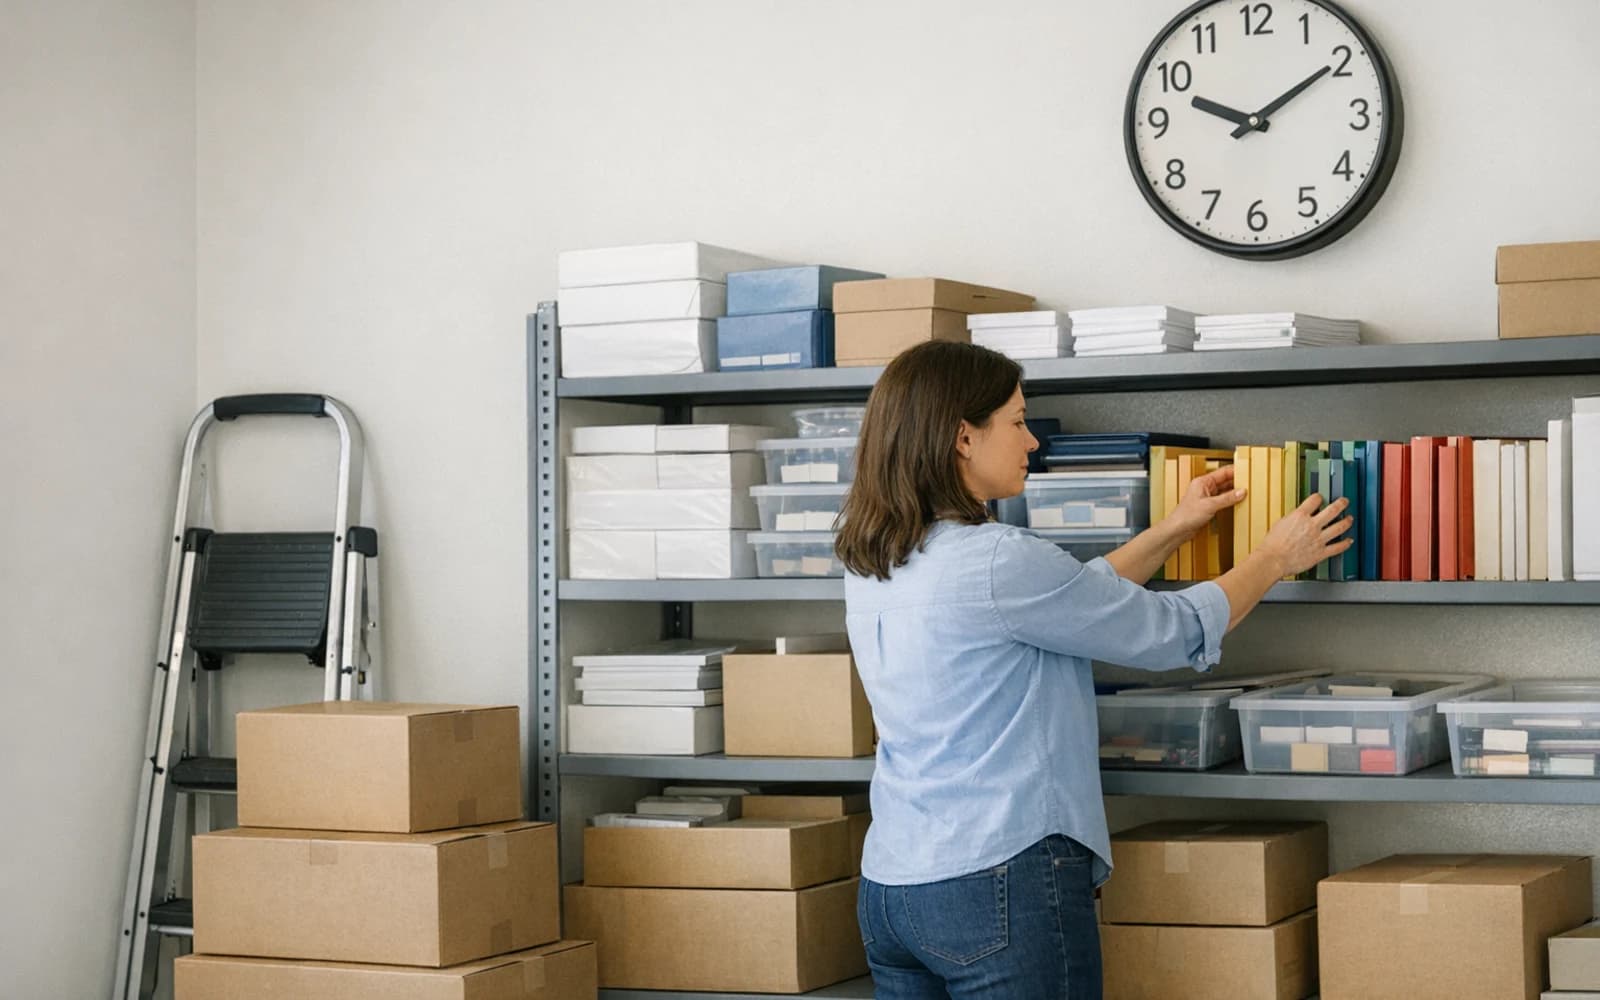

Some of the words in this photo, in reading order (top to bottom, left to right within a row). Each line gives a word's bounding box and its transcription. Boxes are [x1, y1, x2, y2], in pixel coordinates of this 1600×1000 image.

[1239, 3, 1274, 36] 12
[1298, 13, 1309, 45] 1
[1191, 22, 1216, 54] 11
[1157, 60, 1193, 93] 10
[1331, 45, 1353, 77] 2
[1148, 107, 1170, 139] 9
[1349, 98, 1370, 131] 3
[1164, 158, 1187, 190] 8
[1332, 150, 1354, 182] 4
[1201, 189, 1222, 220] 7
[1246, 200, 1268, 232] 6
[1297, 186, 1318, 218] 5
